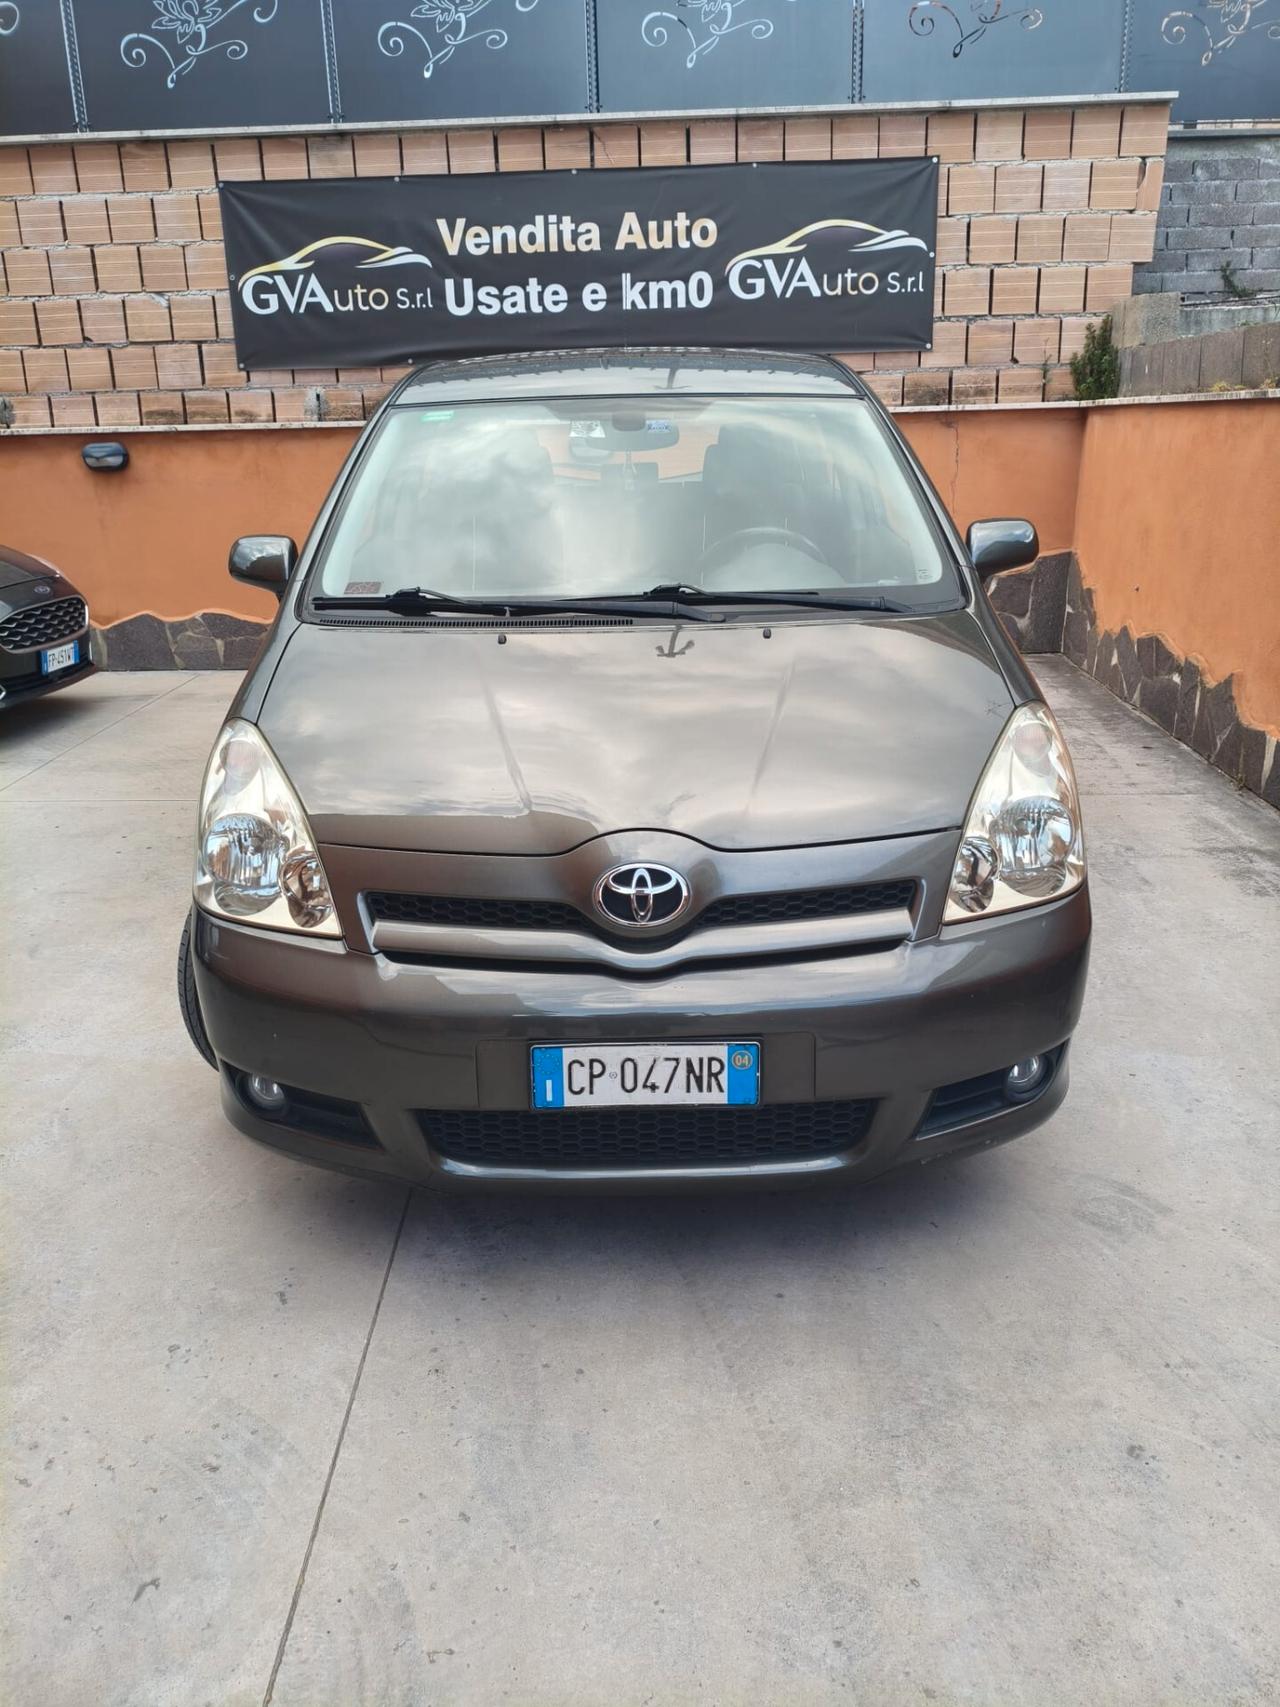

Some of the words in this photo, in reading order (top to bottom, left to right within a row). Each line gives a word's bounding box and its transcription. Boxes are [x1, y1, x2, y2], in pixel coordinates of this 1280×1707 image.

[436, 214, 601, 256] Vendita
[615, 211, 718, 250] Auto
[242, 272, 389, 315] GVAuto
[445, 277, 568, 316] Usate
[582, 281, 607, 311] e
[728, 256, 879, 300] GVAuto
